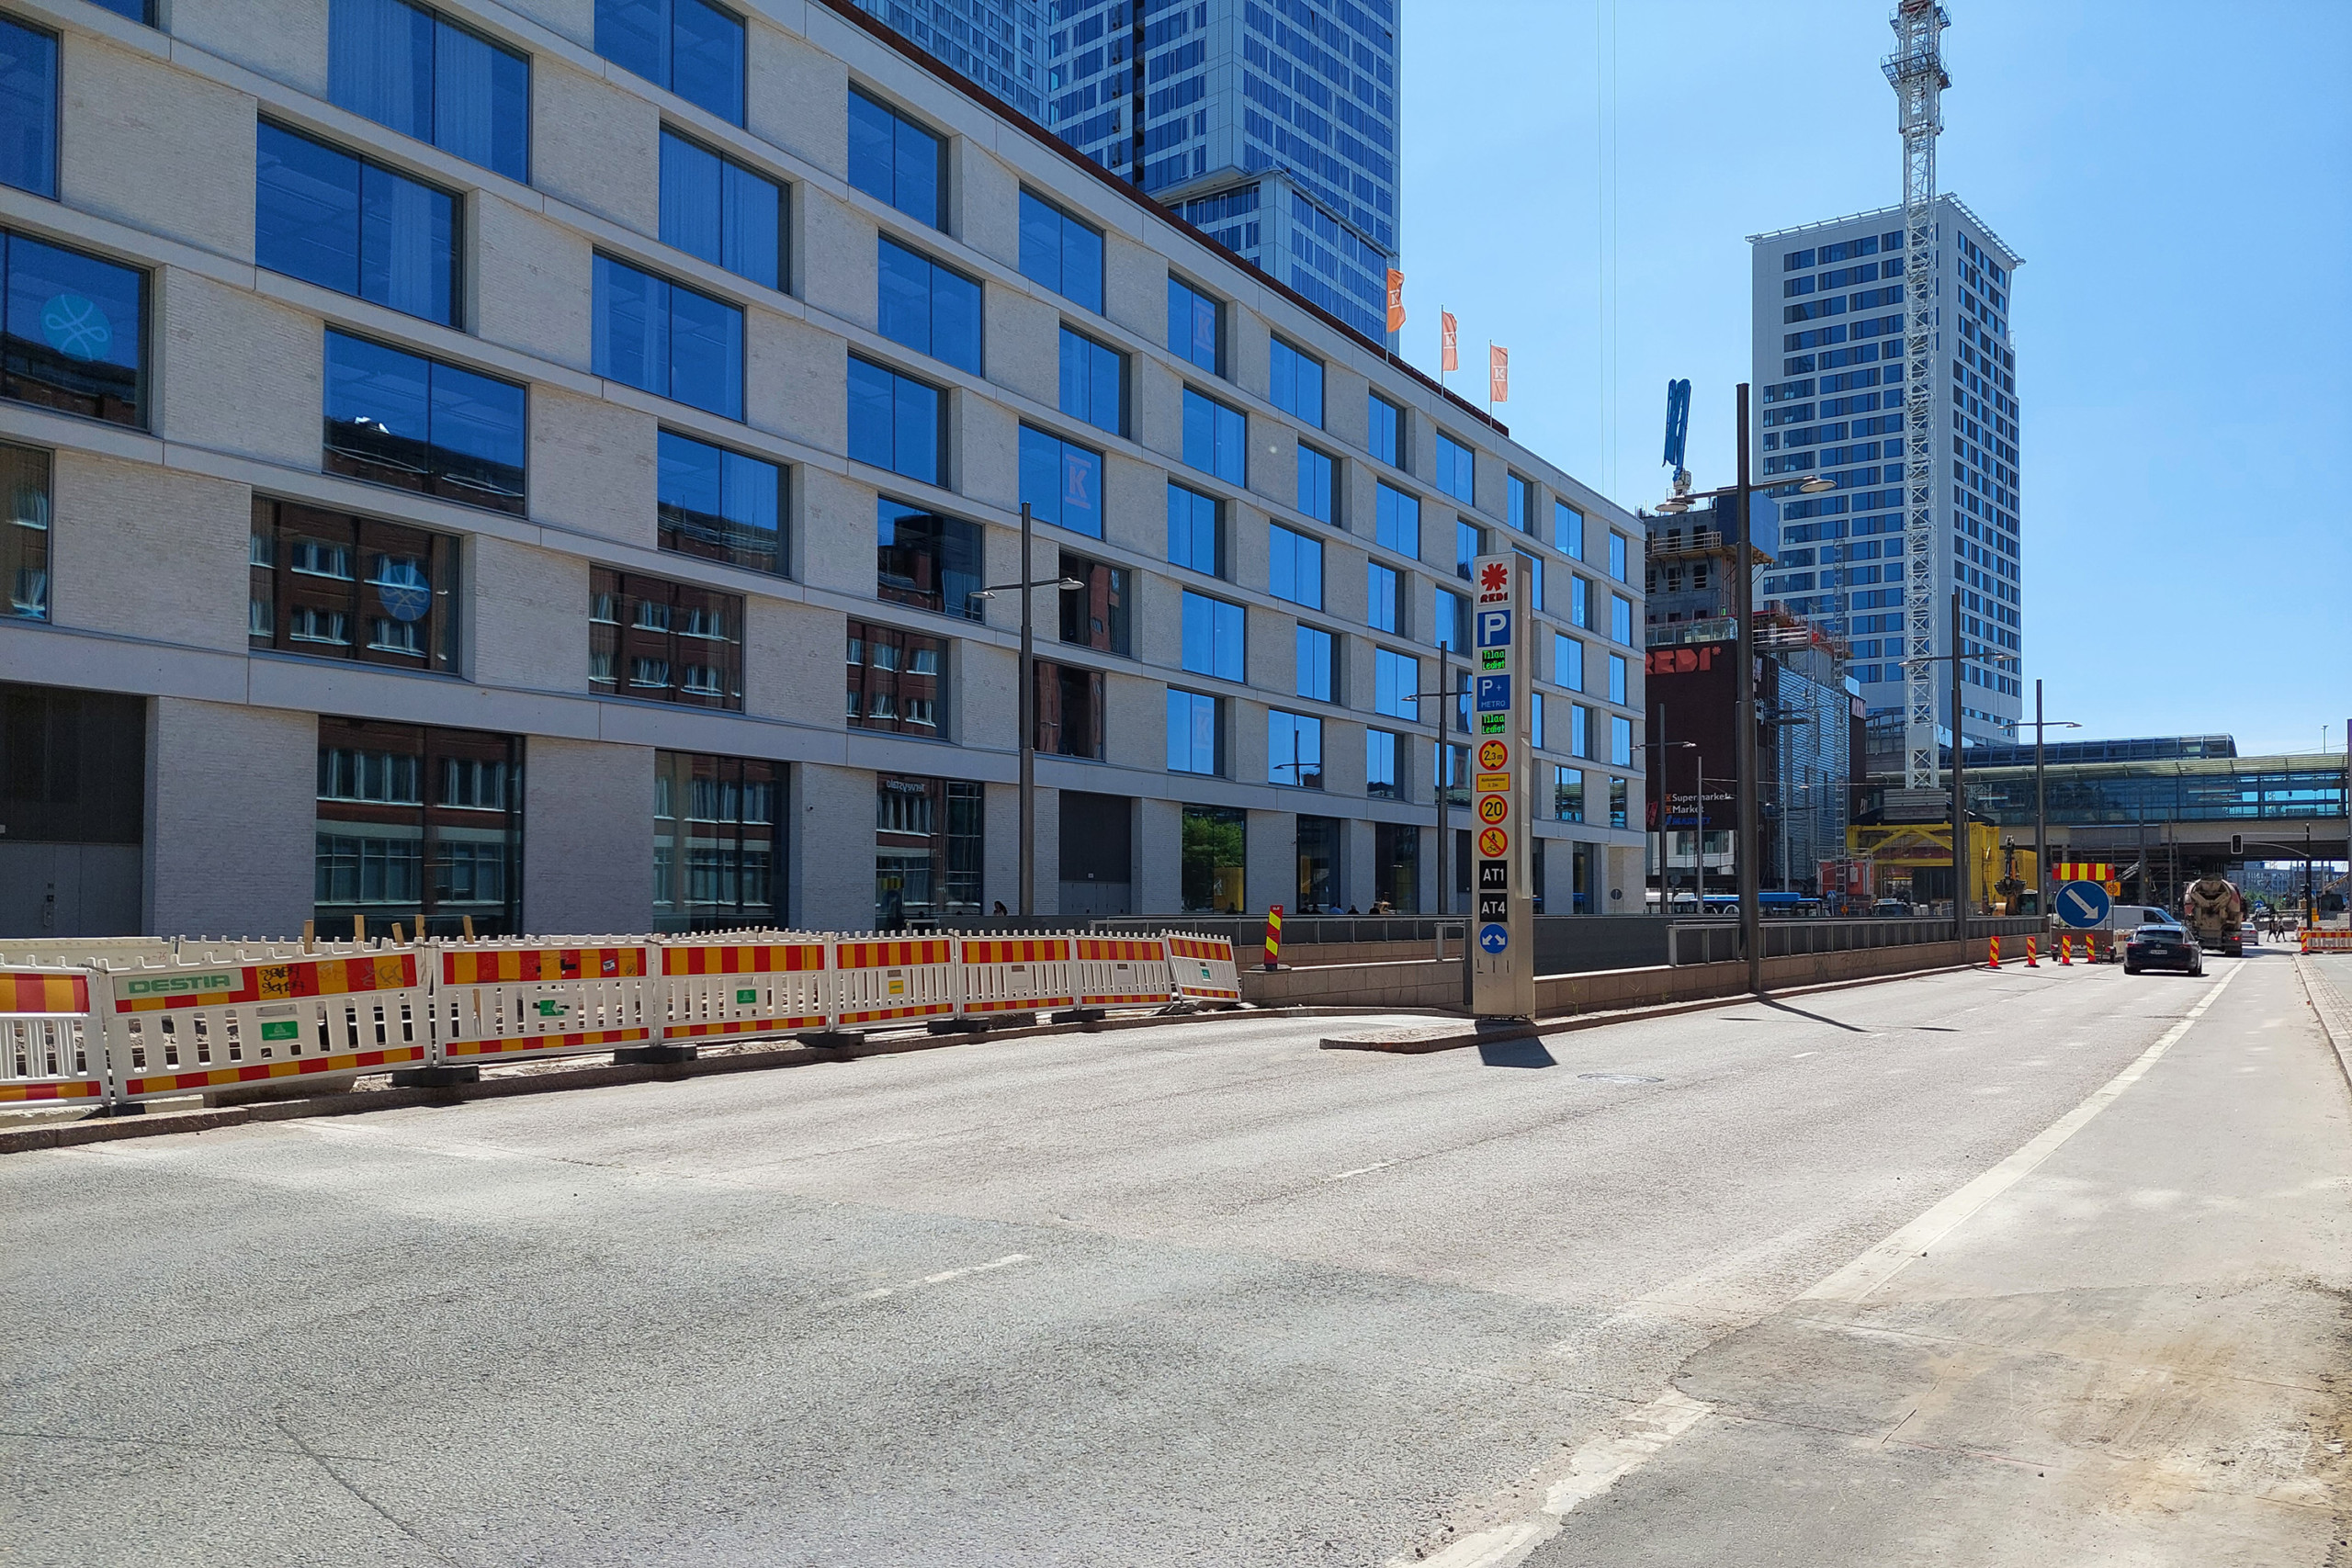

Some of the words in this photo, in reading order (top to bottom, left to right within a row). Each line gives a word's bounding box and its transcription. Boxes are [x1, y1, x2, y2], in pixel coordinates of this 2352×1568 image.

[1480, 592, 1509, 603] REDI
[1485, 613, 1507, 645] P
[1483, 650, 1505, 660] Tilaa
[1482, 660, 1505, 671] Ledigt
[1482, 680, 1493, 696] P
[1483, 714, 1505, 724] Tilaa
[1482, 725, 1505, 734] Ledigt
[1485, 801, 1502, 818] 20
[1483, 868, 1504, 882] AT1
[1481, 901, 1506, 914] AT4
[128, 973, 232, 995] DESTIA
